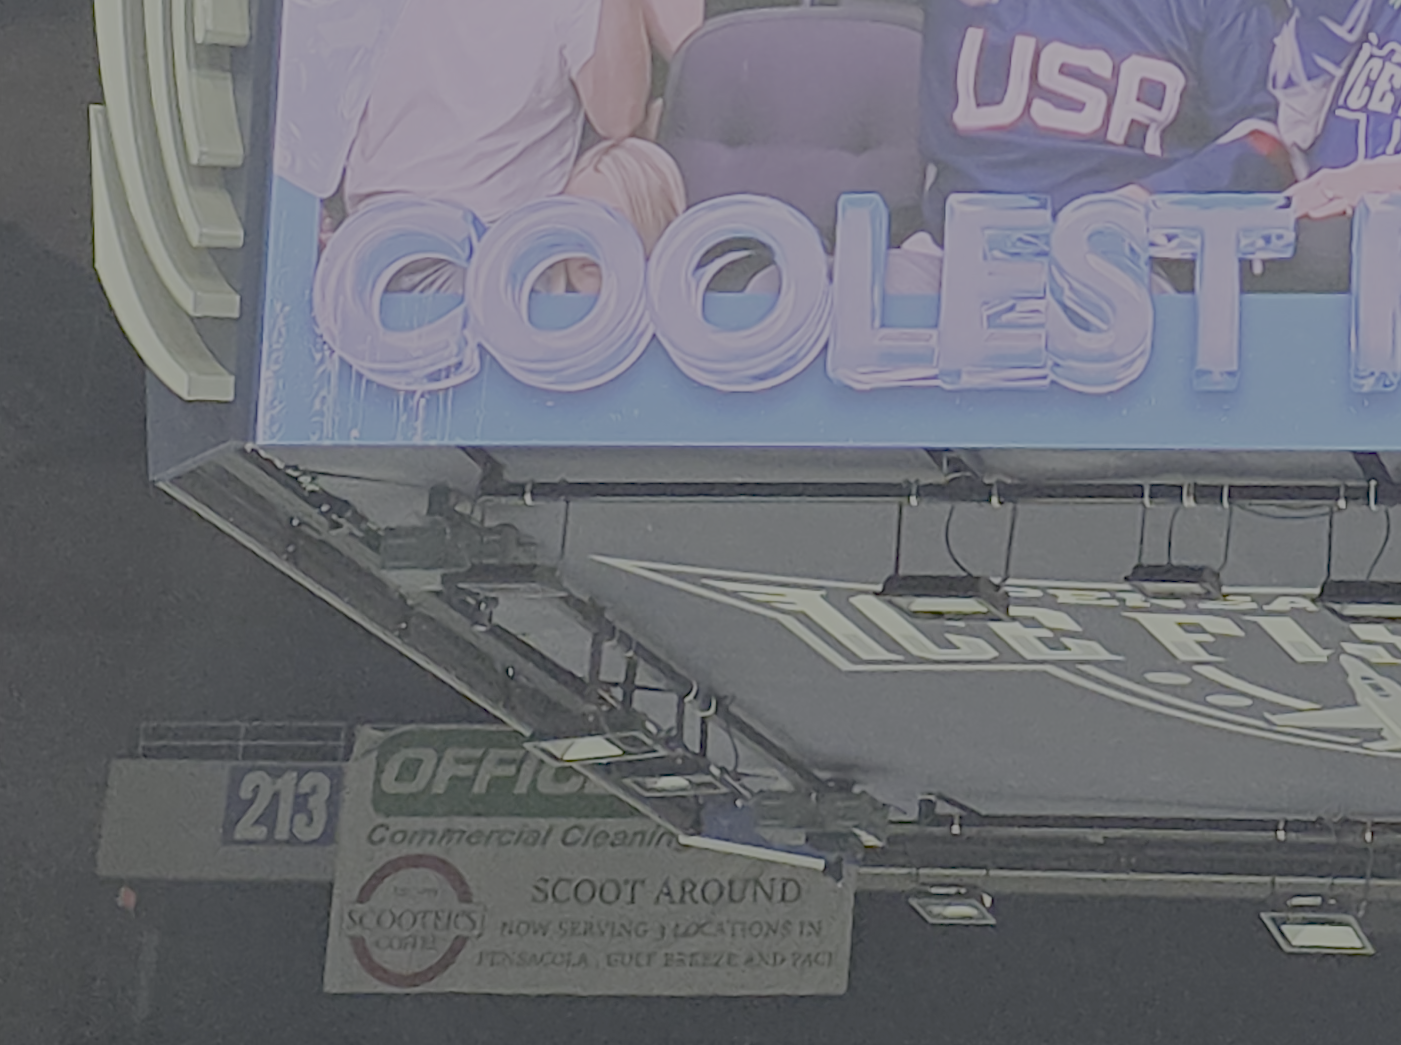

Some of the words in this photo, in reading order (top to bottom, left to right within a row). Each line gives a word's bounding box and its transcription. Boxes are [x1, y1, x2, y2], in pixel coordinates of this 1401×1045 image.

[952, 25, 1187, 156] USA
[312, 191, 1297, 394] COOLEST
[700, 578, 1125, 662] ICE
[233, 770, 332, 842] 213
[380, 748, 612, 795] OFFIC
[366, 823, 553, 848] Commercial
[530, 876, 648, 906] SCOOT
[654, 876, 803, 906] AROUND
